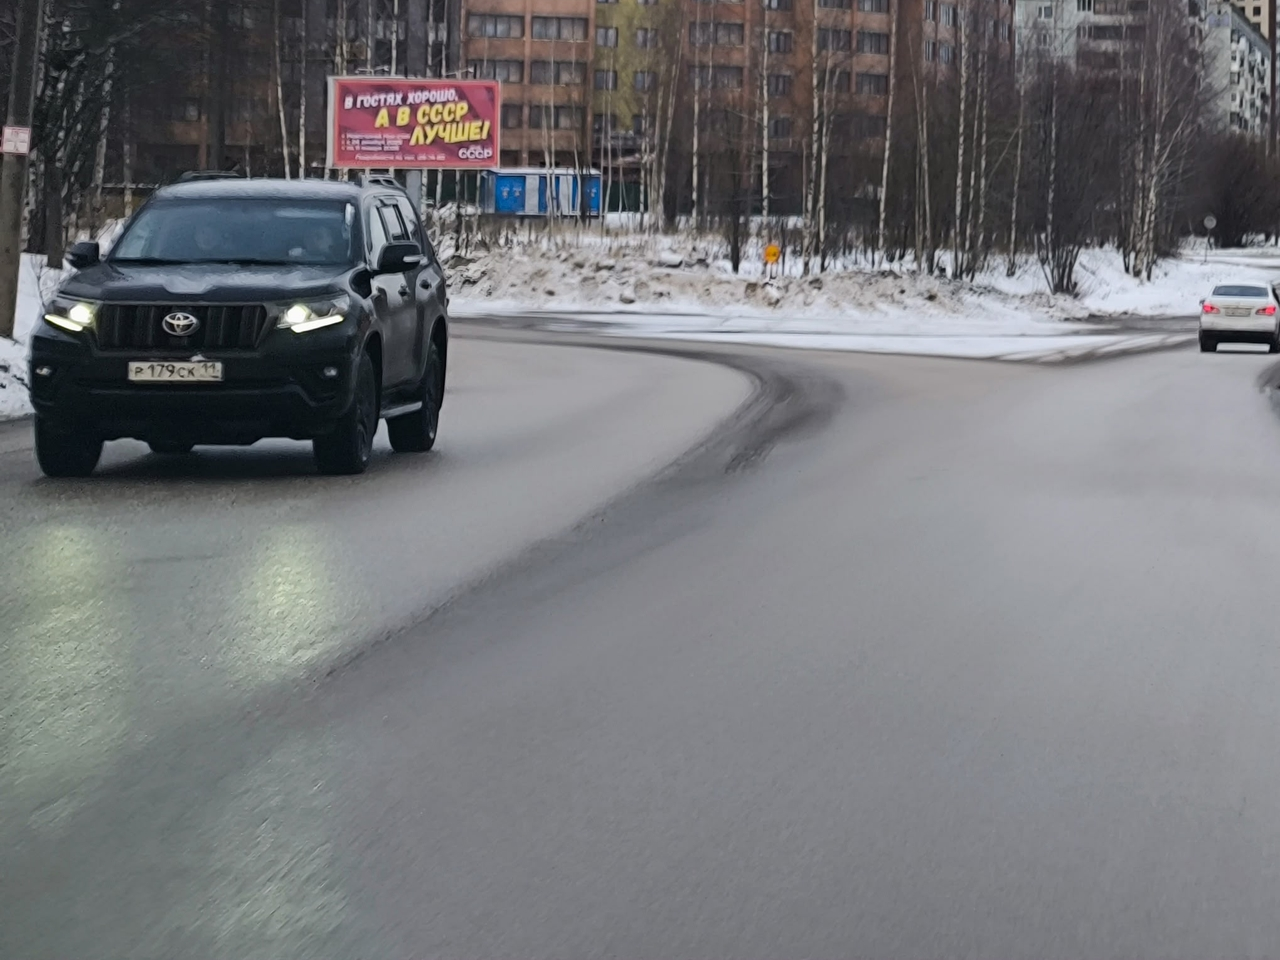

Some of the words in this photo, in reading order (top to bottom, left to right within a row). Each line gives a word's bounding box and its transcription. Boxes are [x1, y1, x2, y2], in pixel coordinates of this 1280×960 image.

[344, 95, 353, 110] В
[356, 93, 403, 109] ГОСТЯХ
[374, 107, 390, 128] А
[396, 106, 410, 126] В
[416, 101, 469, 125] СССР
[409, 121, 491, 146] ЛУЧШЕ!
